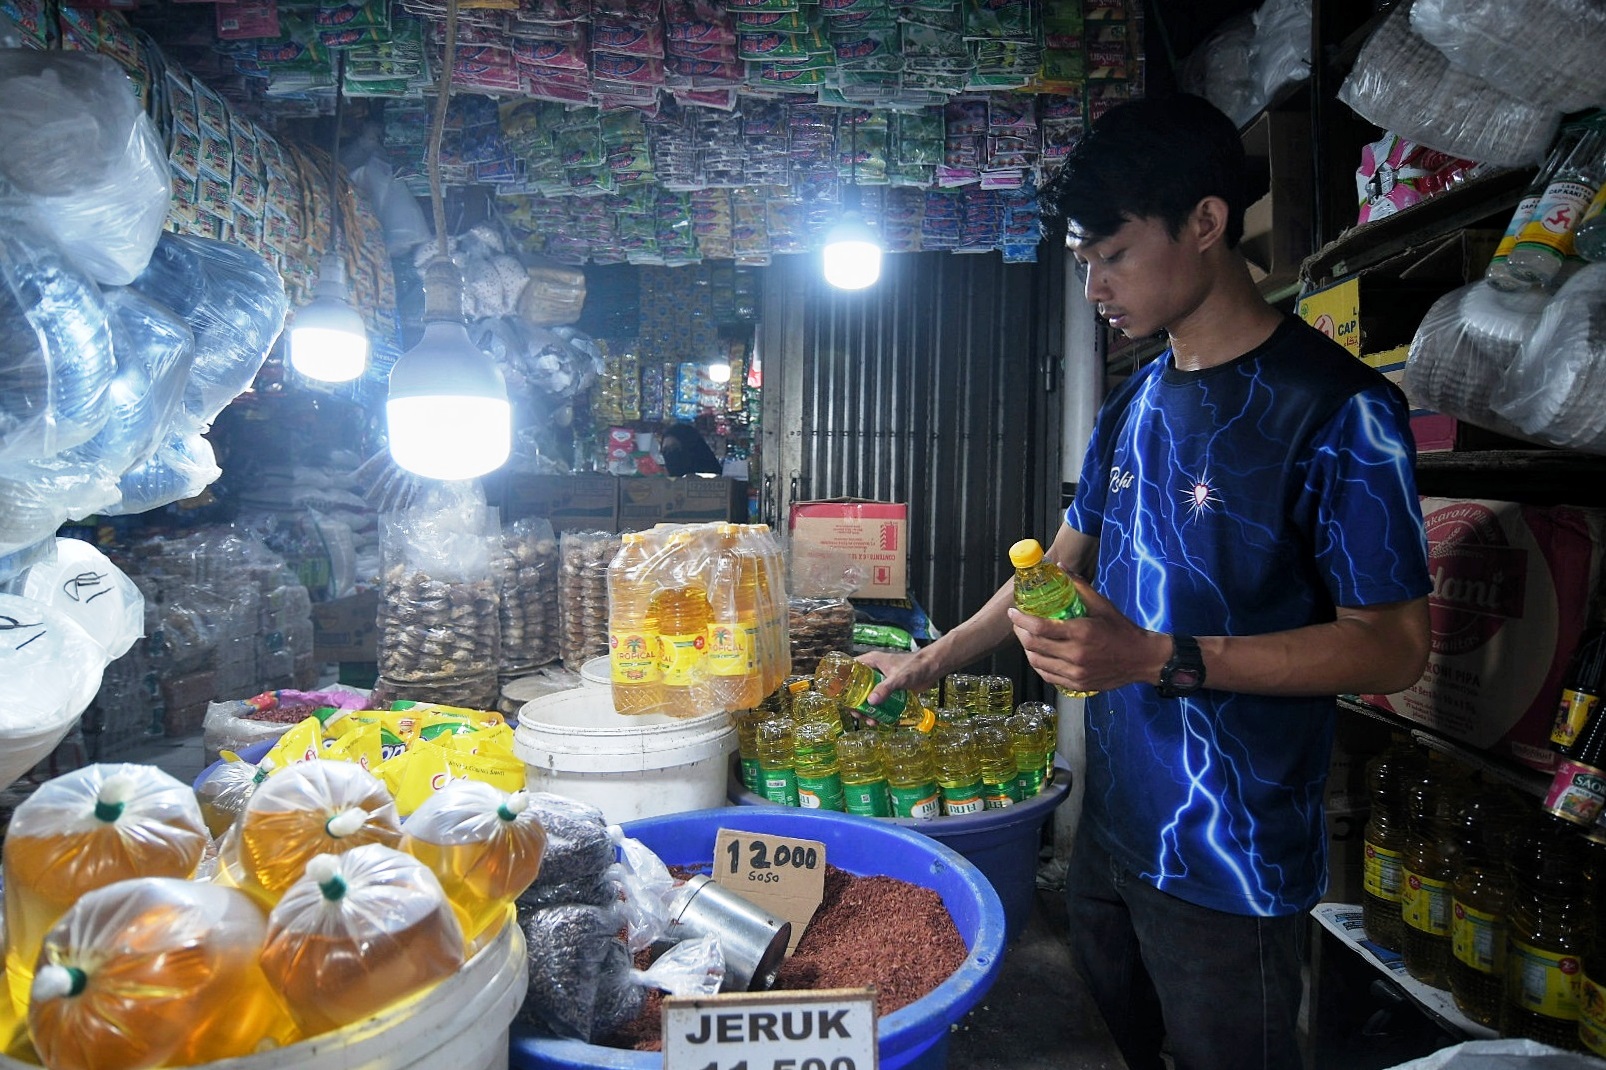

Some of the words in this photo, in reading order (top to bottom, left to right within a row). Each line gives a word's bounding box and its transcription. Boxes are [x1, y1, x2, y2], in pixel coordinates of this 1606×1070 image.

[1338, 320, 1357, 336] CAP
[1423, 506, 1472, 529] akaroni
[1431, 634, 1480, 649] ualitas
[727, 839, 817, 874] 12000
[685, 1008, 852, 1045] JERUK
